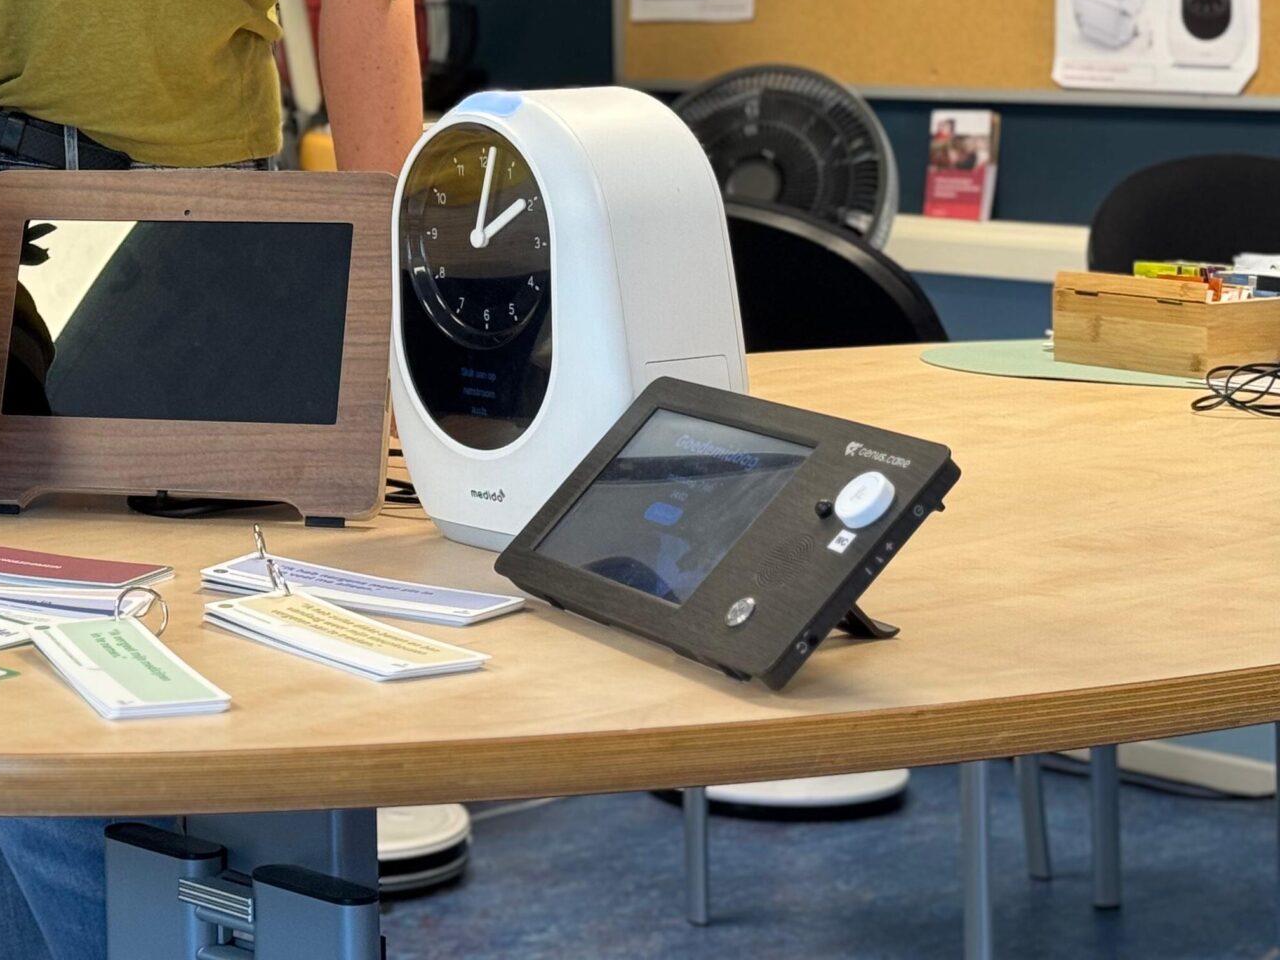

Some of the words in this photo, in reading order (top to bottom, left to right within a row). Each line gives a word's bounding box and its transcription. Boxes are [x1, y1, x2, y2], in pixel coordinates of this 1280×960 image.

[457, 165, 465, 176] 11
[508, 167, 512, 179] 1
[436, 192, 446, 204] 10
[527, 200, 534, 211] 2
[431, 228, 438, 239] 9
[534, 237, 541, 249] 3
[439, 267, 445, 278] 8
[527, 276, 534, 287] 4
[459, 297, 465, 309] 7
[508, 303, 515, 315] 5
[483, 309, 490, 321] 6
[675, 434, 760, 471] Goedemiddag
[470, 489, 504, 503] medido
